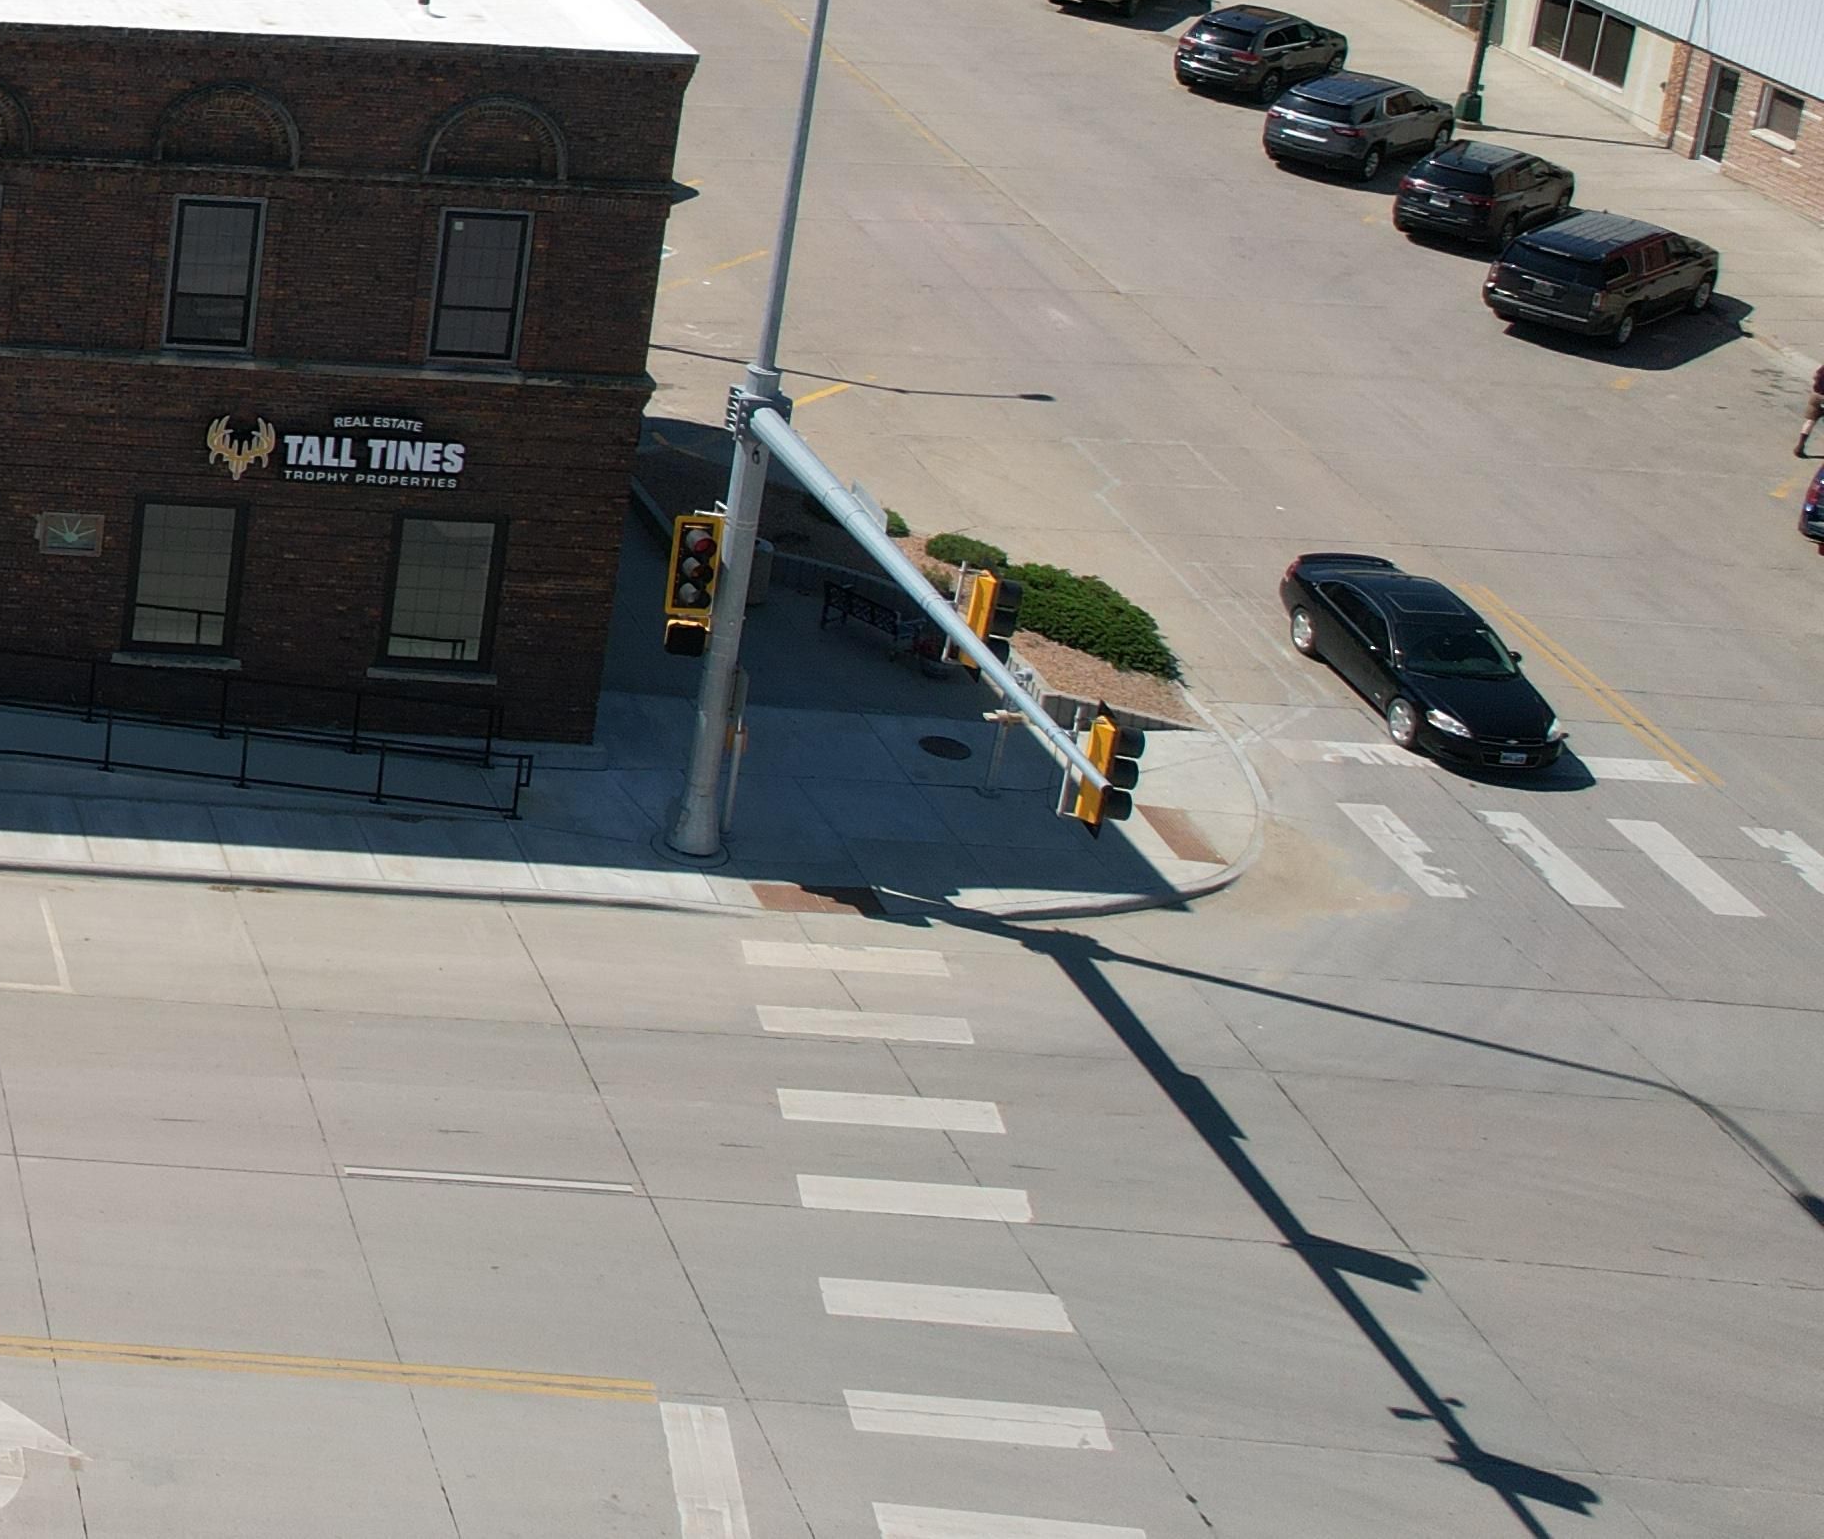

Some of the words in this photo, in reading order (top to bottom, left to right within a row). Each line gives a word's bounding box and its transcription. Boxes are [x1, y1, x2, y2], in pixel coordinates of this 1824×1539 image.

[333, 416, 370, 428] REAL
[373, 417, 424, 433] ESTATE
[283, 435, 357, 468] TALL
[367, 439, 466, 474] TINES
[284, 470, 350, 483] TROPHY
[355, 473, 458, 489] PROPERTIES
